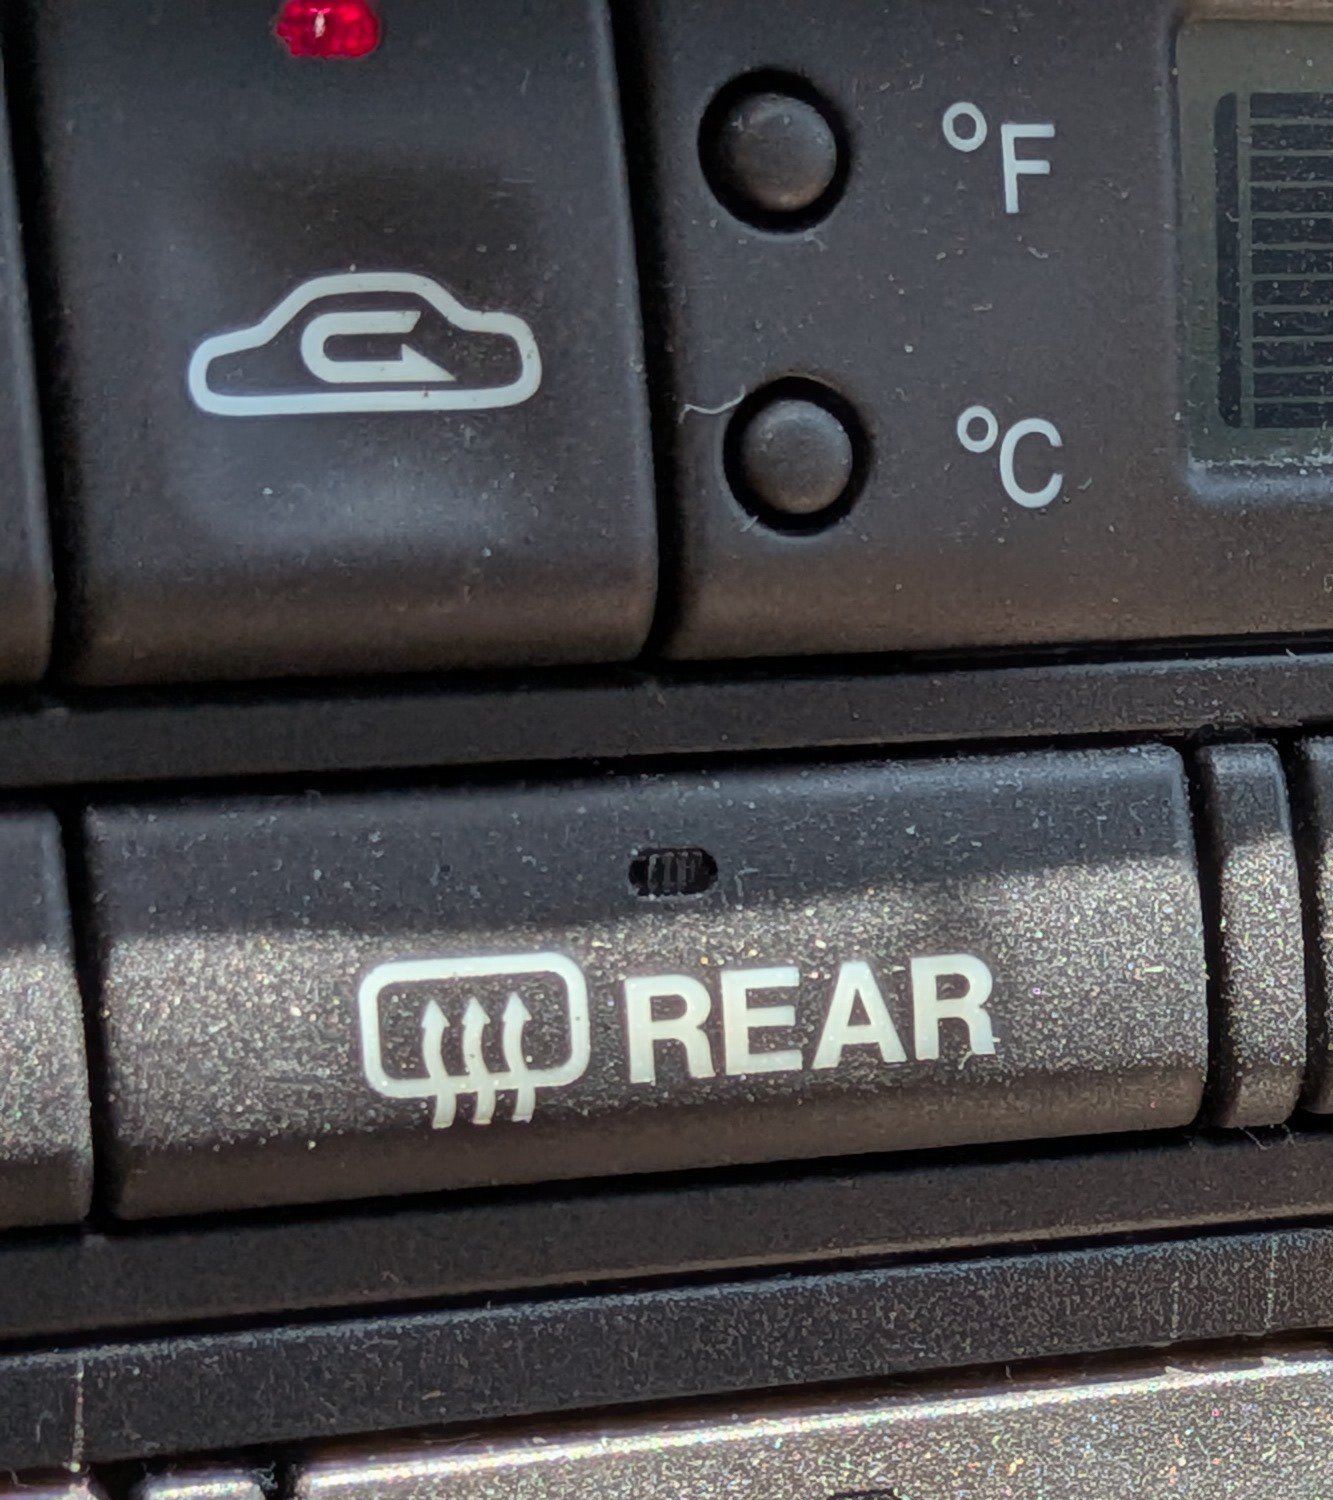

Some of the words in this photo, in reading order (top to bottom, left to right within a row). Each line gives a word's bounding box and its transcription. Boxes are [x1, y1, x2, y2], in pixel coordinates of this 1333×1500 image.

[942, 101, 1055, 214] °F
[956, 405, 1063, 508] °C
[617, 953, 1001, 1085] REAR
